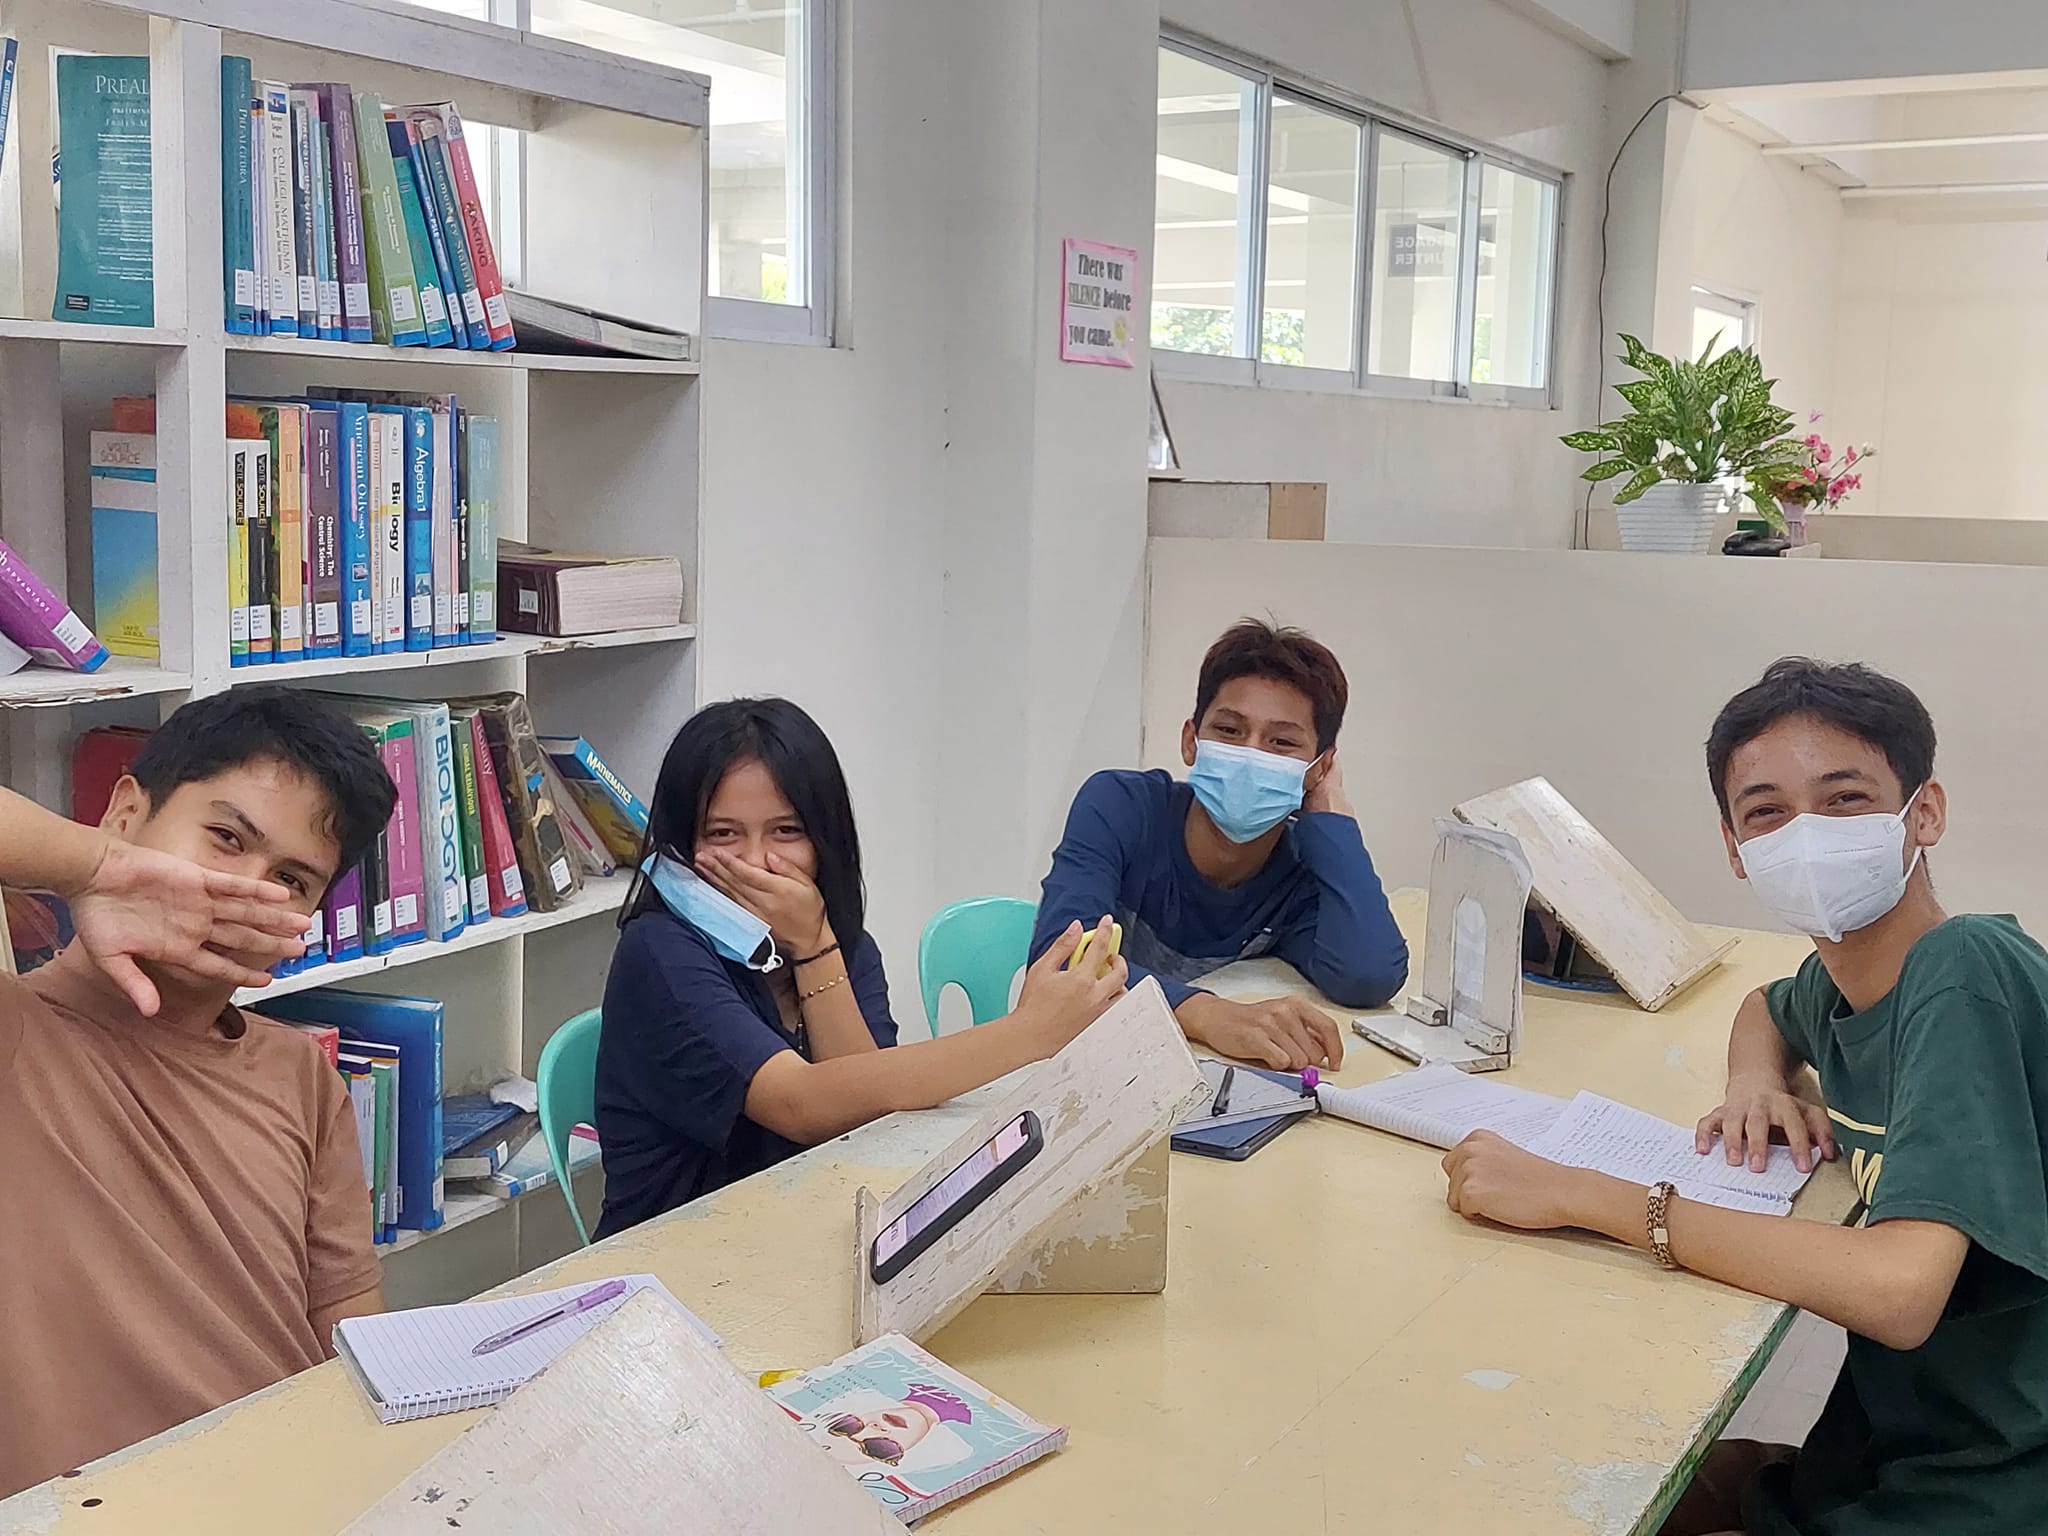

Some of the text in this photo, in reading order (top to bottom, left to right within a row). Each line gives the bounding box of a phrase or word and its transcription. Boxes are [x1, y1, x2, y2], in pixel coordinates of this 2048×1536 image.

[95, 74, 149, 95] PREAL
[277, 146, 287, 199] COLLEGE
[1079, 254, 1123, 281] There was
[1068, 282, 1131, 311] SILENCE before
[1068, 325, 1086, 345] you
[354, 415, 367, 540] American Odyssey
[414, 446, 428, 503] Algebra
[236, 483, 244, 523] SOURCE
[258, 484, 266, 525] SOURCE
[317, 516, 325, 577] Central Science
[326, 560, 334, 576] The
[6, 567, 51, 613] ADVANTAGE
[586, 751, 633, 804] MATHEMATICS
